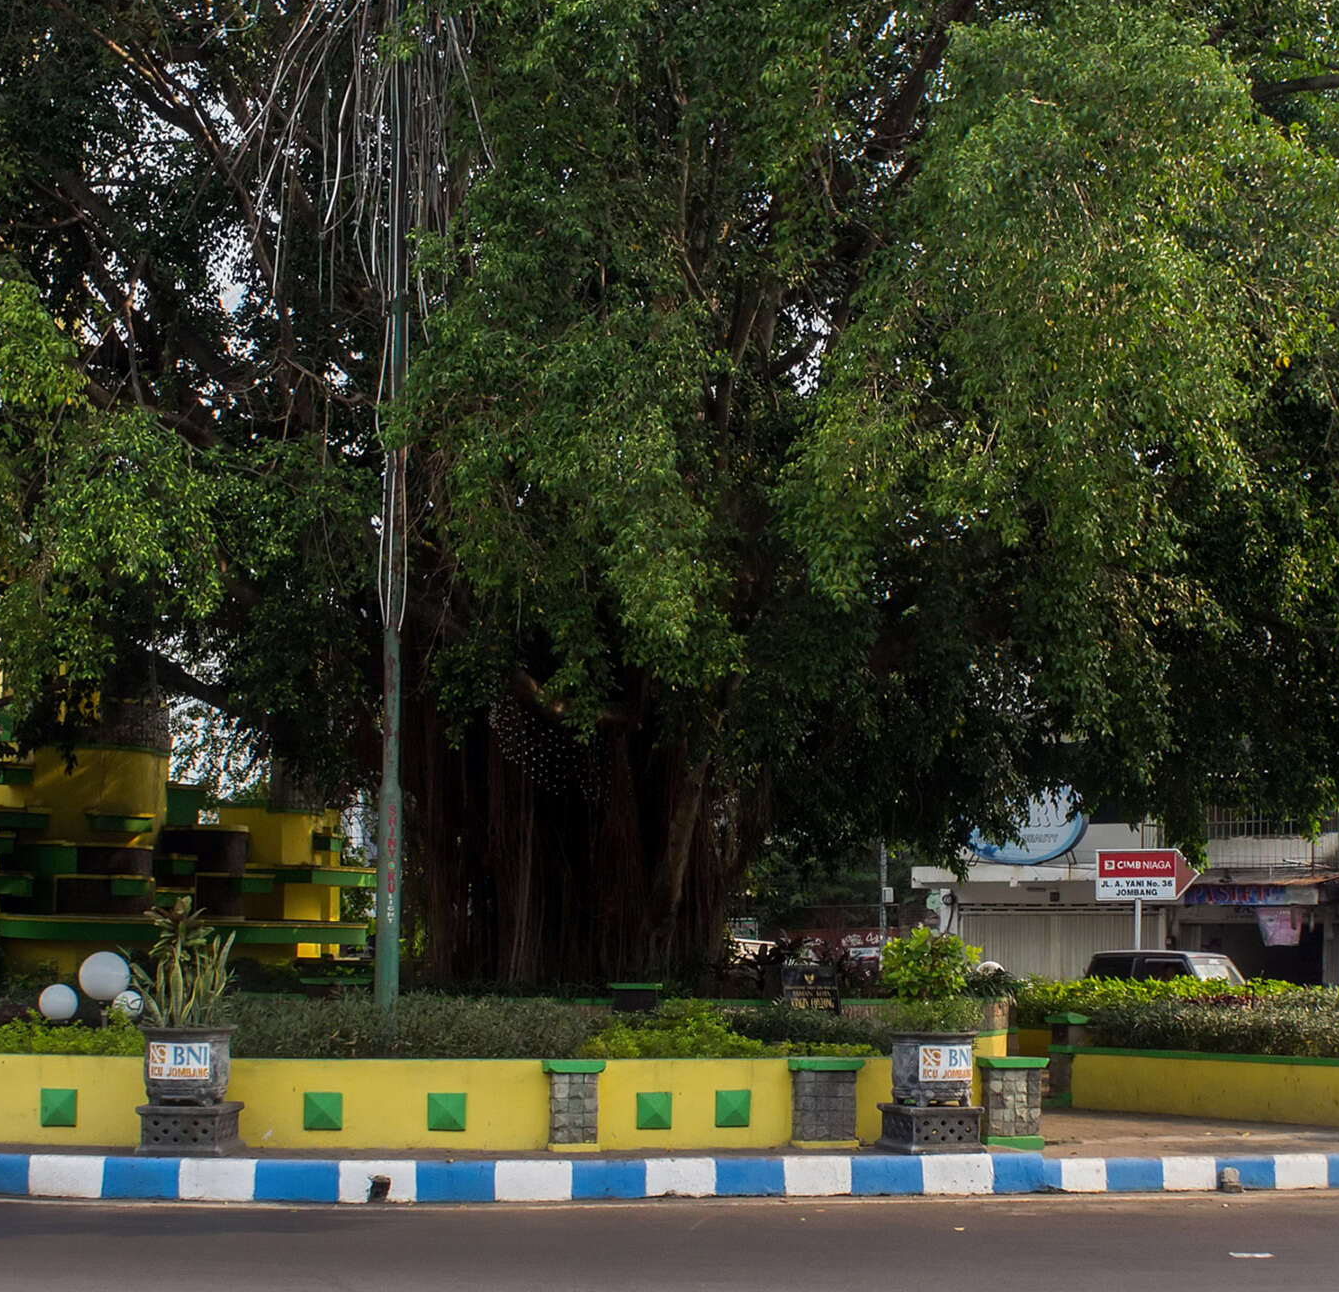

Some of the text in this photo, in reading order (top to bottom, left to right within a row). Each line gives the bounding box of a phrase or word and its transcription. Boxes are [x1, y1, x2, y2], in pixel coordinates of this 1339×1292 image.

[1116, 860, 1172, 869] CIMB NIAGA
[1101, 880, 1114, 888] JL.
[1115, 880, 1123, 888] A.
[1125, 880, 1145, 888] YANI
[1146, 880, 1160, 888] No.
[173, 1045, 208, 1066] BNI
[166, 1067, 209, 1077] JOMBANG
[923, 1069, 938, 1078] KCU
